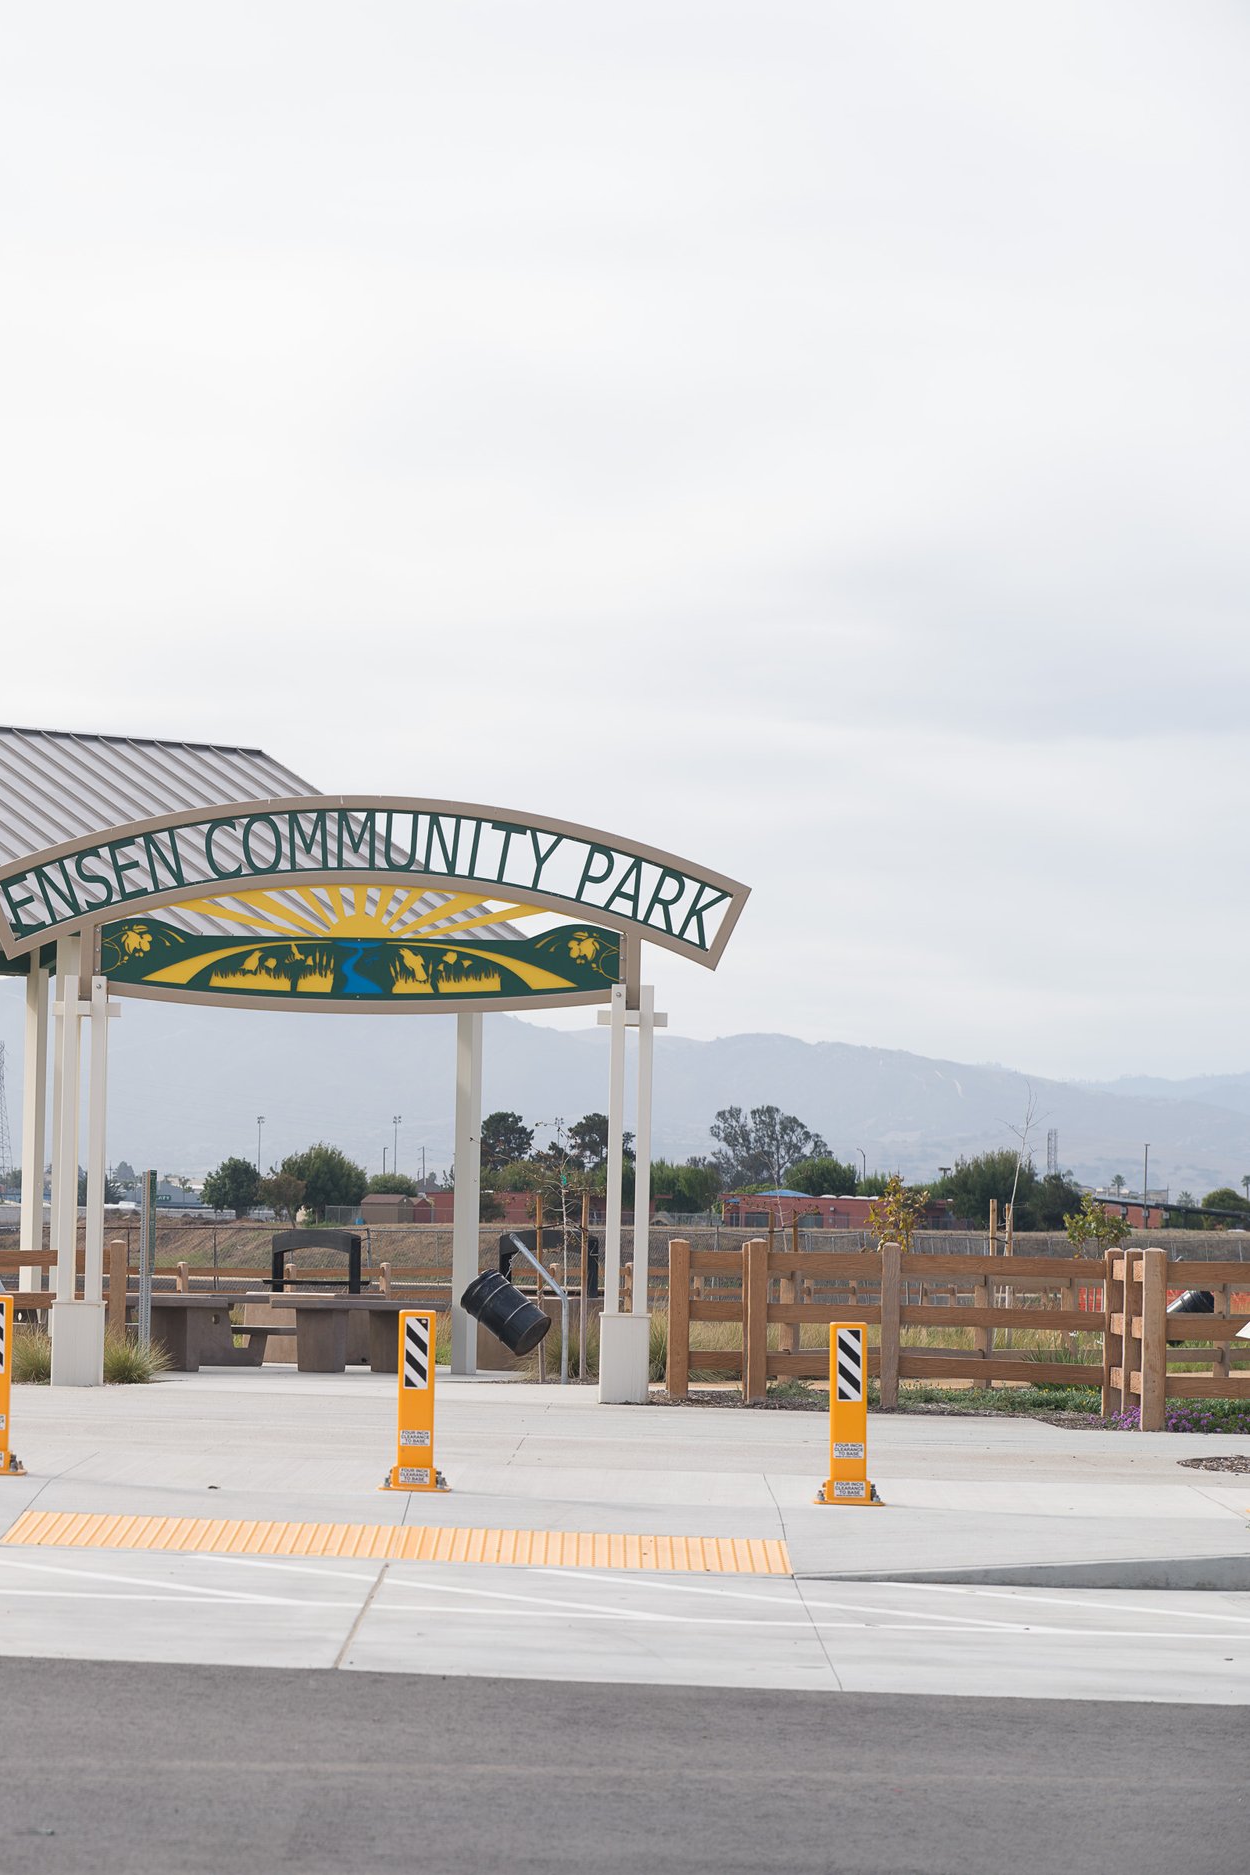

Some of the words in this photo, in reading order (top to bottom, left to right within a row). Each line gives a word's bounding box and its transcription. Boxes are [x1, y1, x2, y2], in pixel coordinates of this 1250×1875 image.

[0, 828, 185, 938] ENSEN
[204, 809, 563, 889] COMMUNITY
[575, 844, 732, 950] PARK
